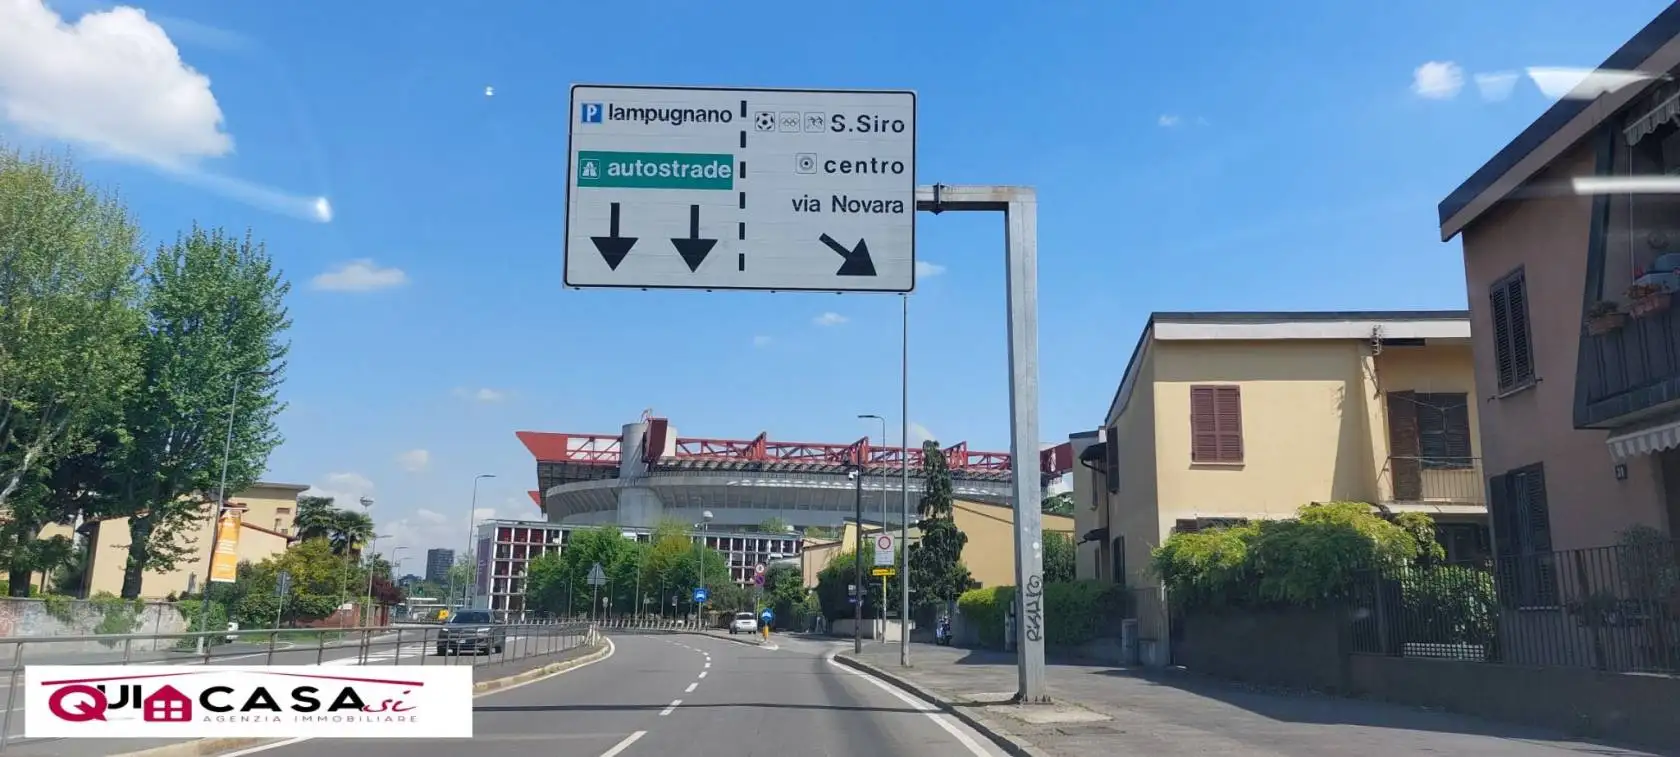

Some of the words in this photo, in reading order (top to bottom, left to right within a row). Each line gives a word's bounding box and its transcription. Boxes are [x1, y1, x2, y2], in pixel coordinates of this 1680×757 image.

[608, 103, 733, 125] lampugnano
[831, 114, 905, 133] S.Siro
[607, 160, 731, 178] autostrade
[824, 158, 904, 174] centro
[792, 194, 821, 212] via
[832, 195, 904, 213] Novara
